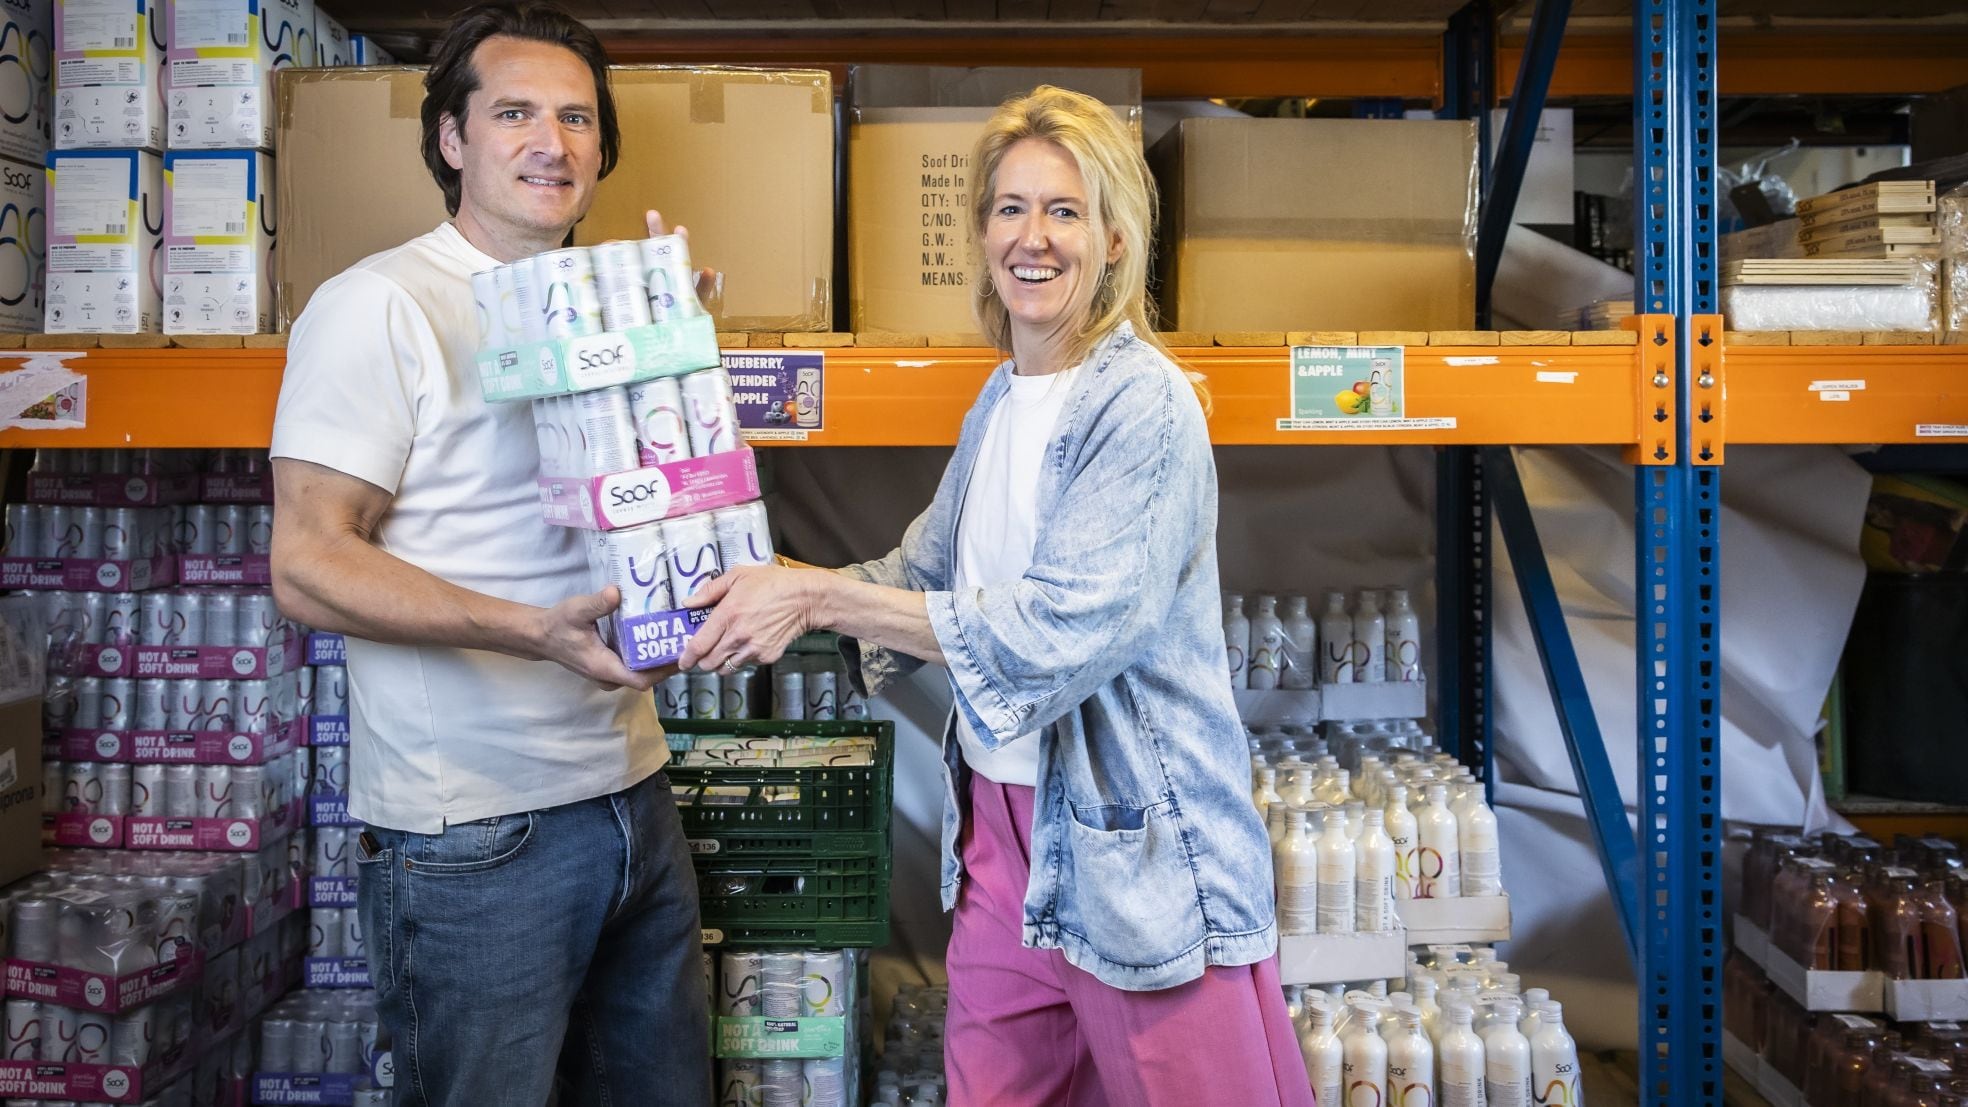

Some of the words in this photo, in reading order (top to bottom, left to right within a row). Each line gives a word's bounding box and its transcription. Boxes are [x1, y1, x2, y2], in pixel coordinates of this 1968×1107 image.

[922, 154, 947, 168] Soof
[951, 154, 969, 168] Dri
[921, 174, 950, 188] Made
[954, 174, 965, 188] In
[921, 193, 949, 208] QTY:
[922, 213, 956, 227] C/NO:
[922, 271, 968, 286] MEANS:
[1297, 348, 1341, 361] LEMON,
[1346, 348, 1376, 359] MINT
[1297, 365, 1344, 377] &APPLE
[730, 374, 777, 387] VENDER
[2, 563, 23, 573] NOT
[25, 563, 33, 573] A
[184, 560, 205, 570] NOT
[206, 560, 214, 570] A
[2, 575, 28, 584] SOFT
[30, 575, 64, 585] DRINK
[185, 570, 209, 580] SOFT
[211, 570, 243, 580] DRINK
[689, 609, 705, 617] 100%
[690, 615, 700, 623] 0%
[632, 619, 668, 642] NOT
[673, 617, 686, 635] A
[315, 640, 334, 649] NOT
[336, 640, 343, 649] A
[637, 637, 678, 661] SOFT
[138, 652, 161, 663] NOT
[161, 652, 169, 663] A
[314, 650, 338, 660] SOFT
[138, 663, 164, 674] SOFT
[165, 663, 200, 674] DRINK
[316, 722, 336, 732] NOT
[338, 722, 345, 732] A
[135, 736, 157, 747] NOT
[157, 736, 166, 747] A
[316, 732, 340, 742] SOFT
[135, 748, 160, 758] SOFT
[162, 748, 196, 758] DRINK
[315, 802, 336, 813] NOT
[337, 802, 345, 813] A
[316, 813, 340, 823] SOFT
[132, 823, 154, 833] NOT
[155, 823, 164, 833] A
[132, 834, 158, 845] SOFT
[160, 834, 194, 845] DRINK
[314, 881, 335, 892] NOT
[336, 881, 344, 892] A
[314, 892, 339, 902] SOFT
[310, 961, 331, 972] NOT
[333, 961, 340, 972] A
[24, 968, 32, 980] A
[310, 972, 335, 983] SOFT
[337, 972, 370, 983] DRINK
[28, 982, 57, 997] DRINK
[119, 979, 138, 994] NOT
[138, 975, 149, 988] A
[119, 991, 143, 1008] SOFT
[723, 1023, 749, 1037] NOT
[752, 1022, 761, 1036] A
[723, 1039, 754, 1051] SOFT
[758, 1039, 800, 1052] DRINK
[23, 1068, 33, 1080] A
[0, 1081, 27, 1094] SOFT
[29, 1081, 67, 1095] DRINK
[259, 1079, 281, 1090] NOT
[282, 1079, 291, 1090] A
[259, 1090, 285, 1101] SOFT
[287, 1090, 321, 1101] DRINK
